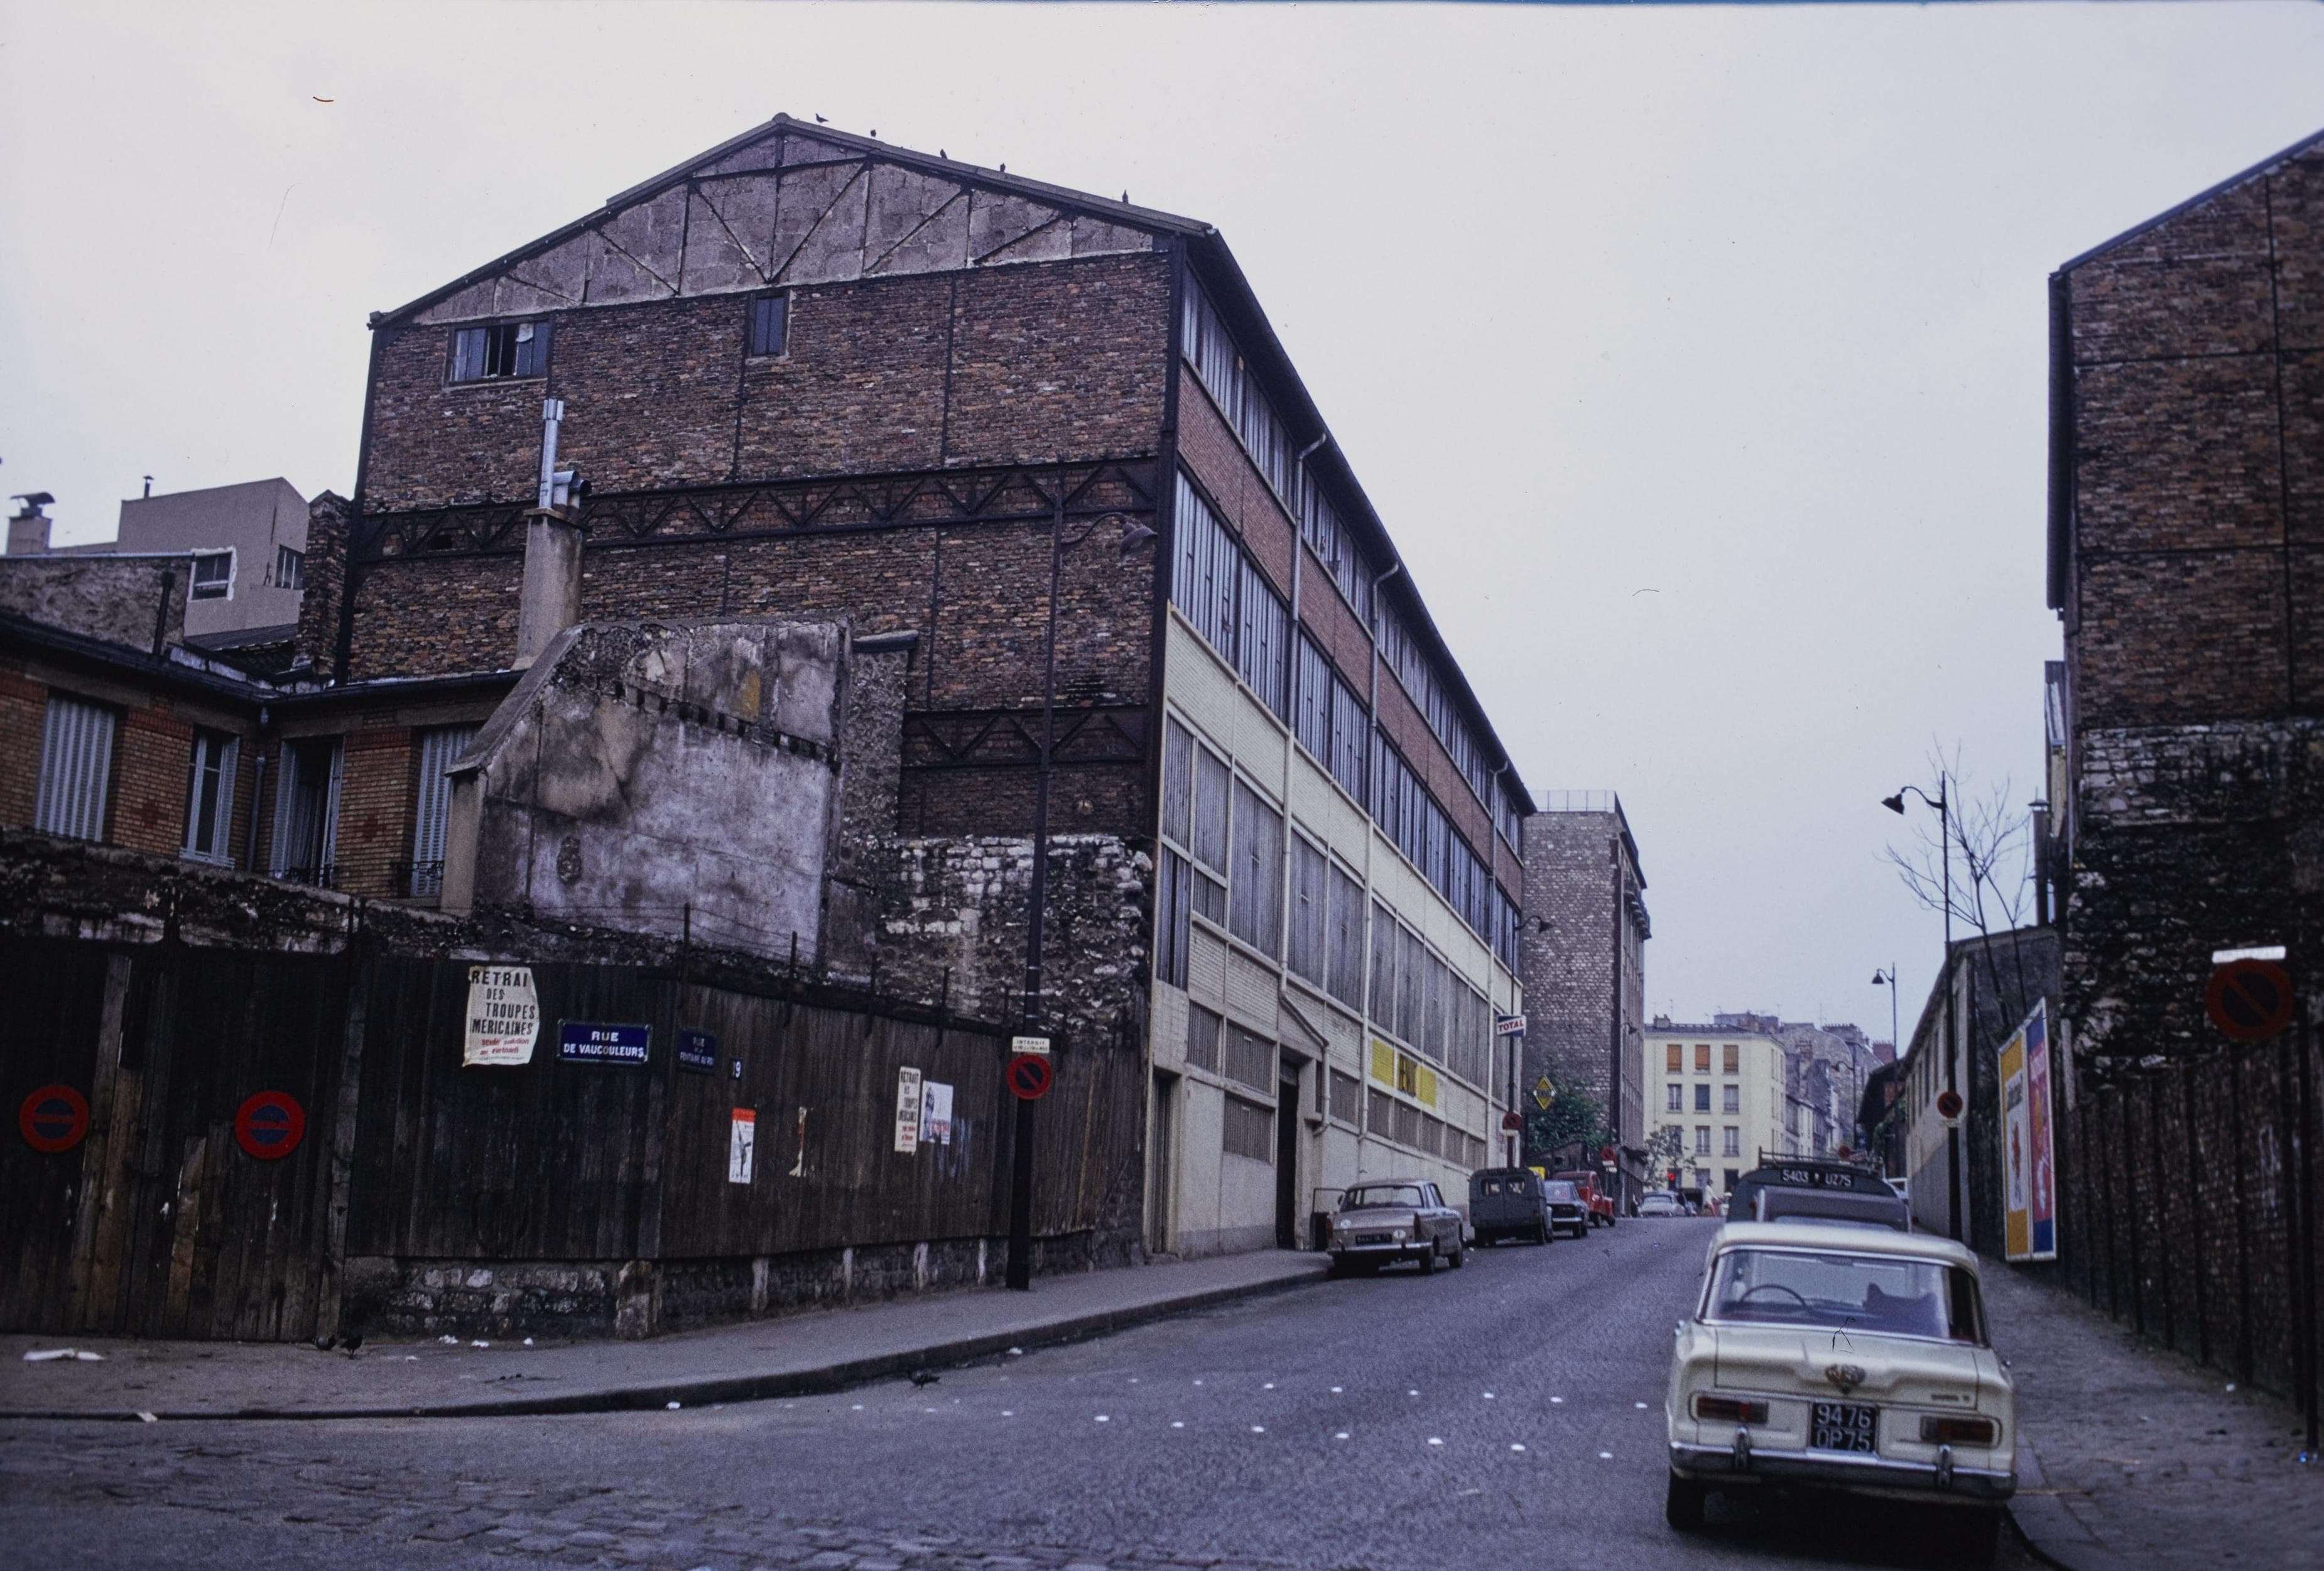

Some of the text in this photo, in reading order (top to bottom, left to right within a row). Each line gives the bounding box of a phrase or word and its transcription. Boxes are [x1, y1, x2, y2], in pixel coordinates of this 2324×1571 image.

[486, 988, 504, 1000] DES
[486, 1003, 535, 1019] TROUPES
[472, 1019, 533, 1035] MERICAINES
[1498, 1020, 1524, 1032] TOTAL
[592, 1031, 619, 1041] RUE
[563, 1043, 644, 1058] DE VAUCOULEURS
[1818, 1405, 1871, 1428] 9476
